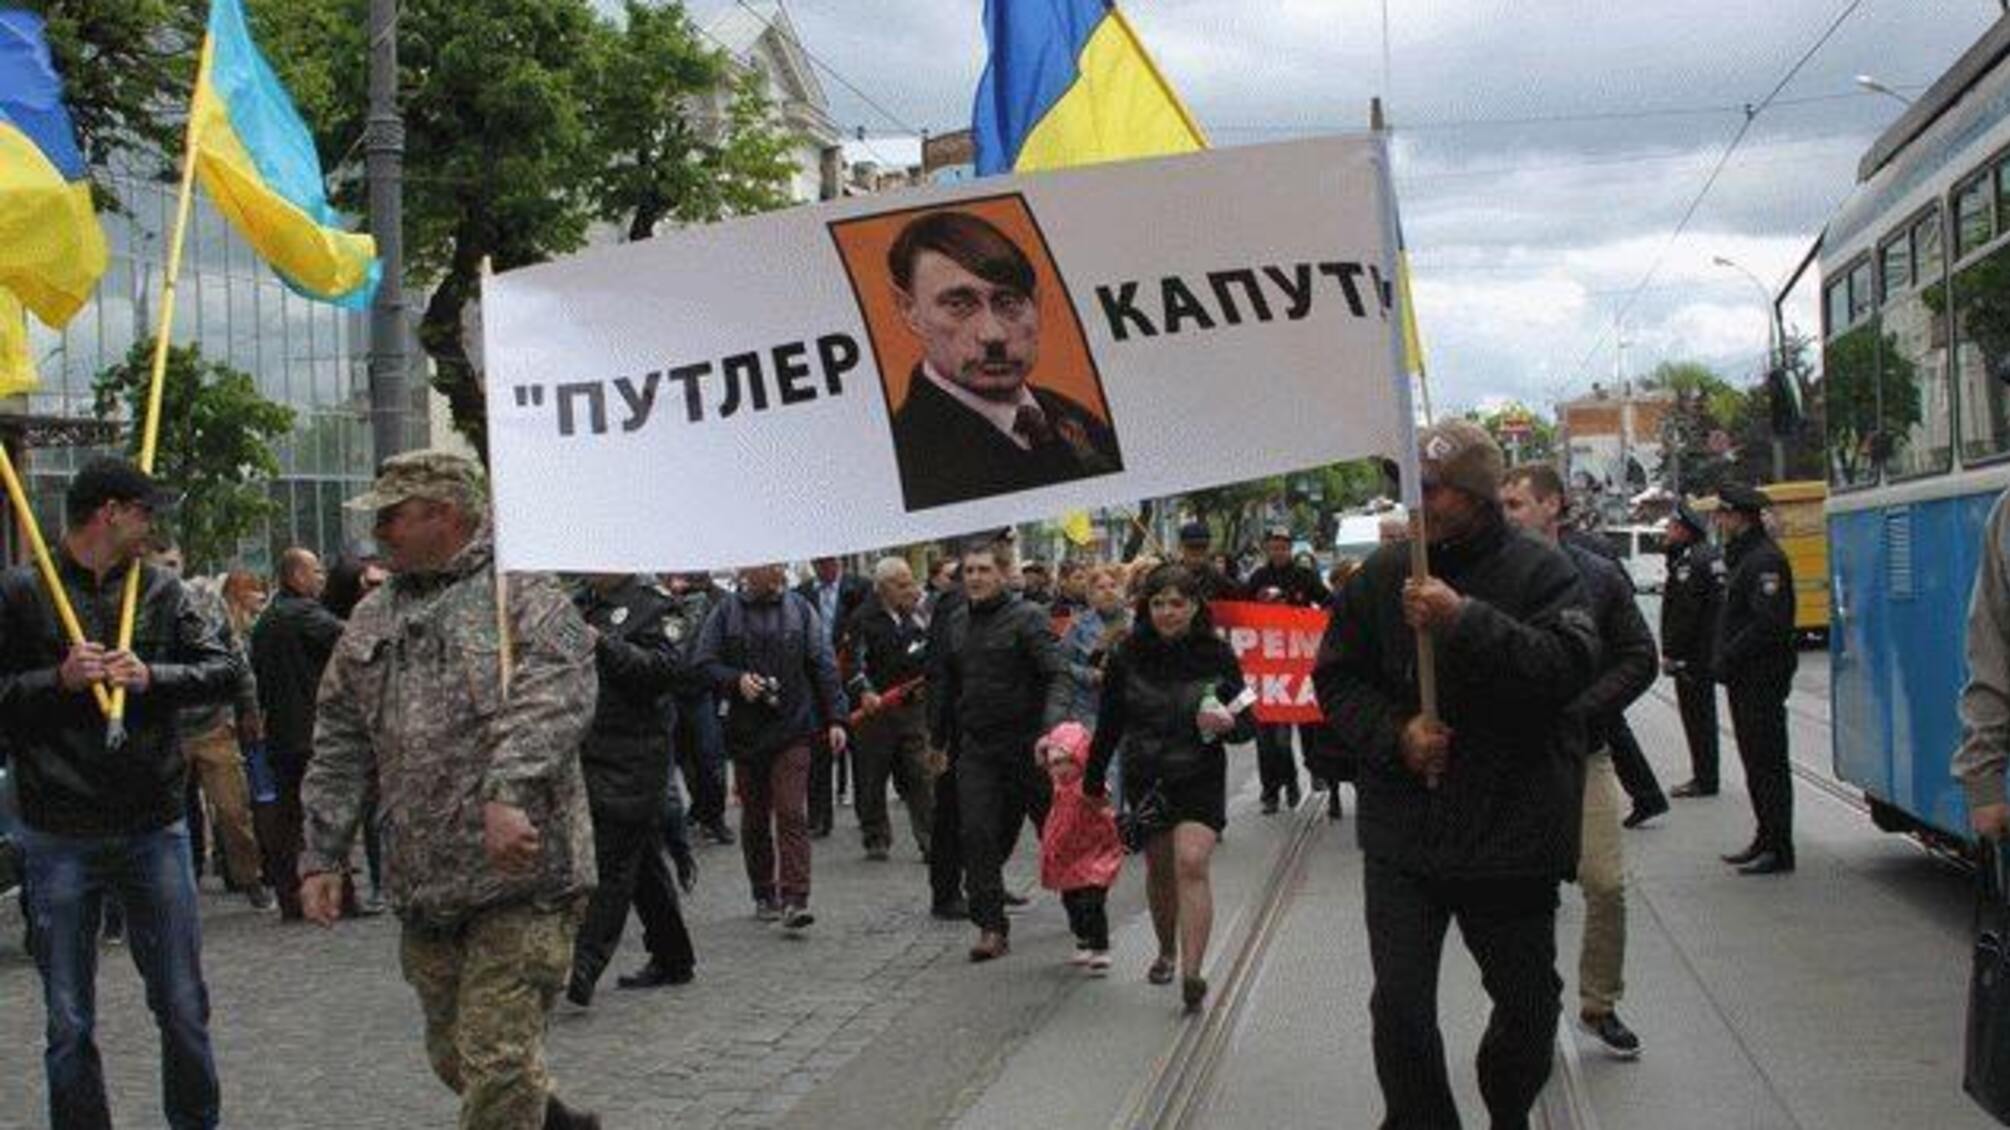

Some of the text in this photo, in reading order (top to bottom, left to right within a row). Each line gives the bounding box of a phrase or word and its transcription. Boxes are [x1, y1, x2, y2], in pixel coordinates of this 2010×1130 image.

[513, 332, 861, 437] "ПУТЛЕР
[1215, 626, 1324, 659] РЕМ
[1243, 673, 1319, 707] КА
